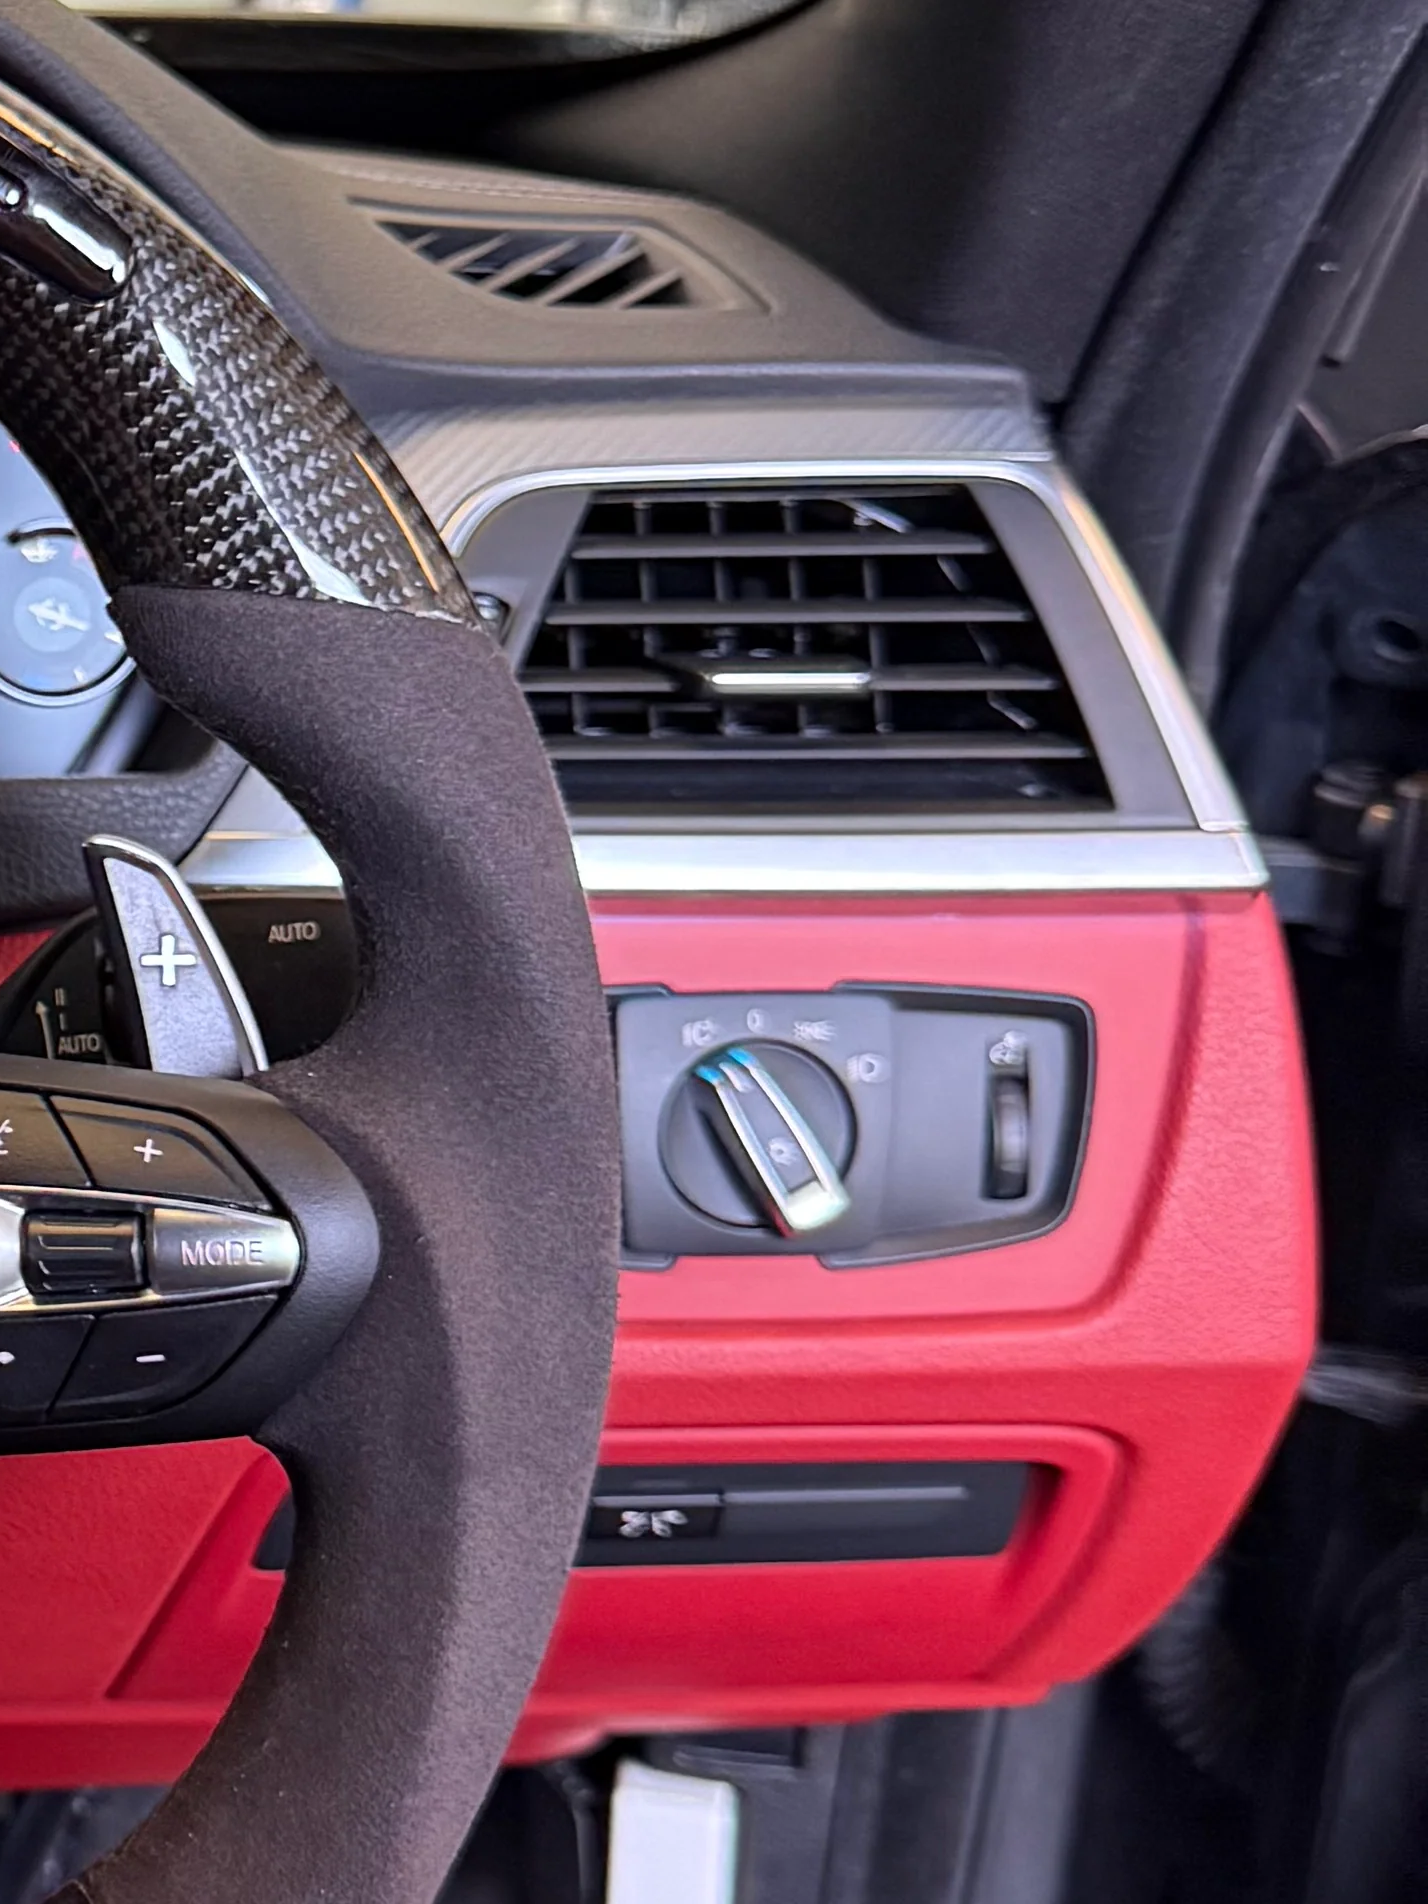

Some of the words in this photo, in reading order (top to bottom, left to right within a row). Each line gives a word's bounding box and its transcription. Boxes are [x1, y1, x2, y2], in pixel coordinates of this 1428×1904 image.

[268, 920, 321, 944] AUTO
[58, 1032, 101, 1055] AUTO
[181, 1239, 263, 1267] MODE
